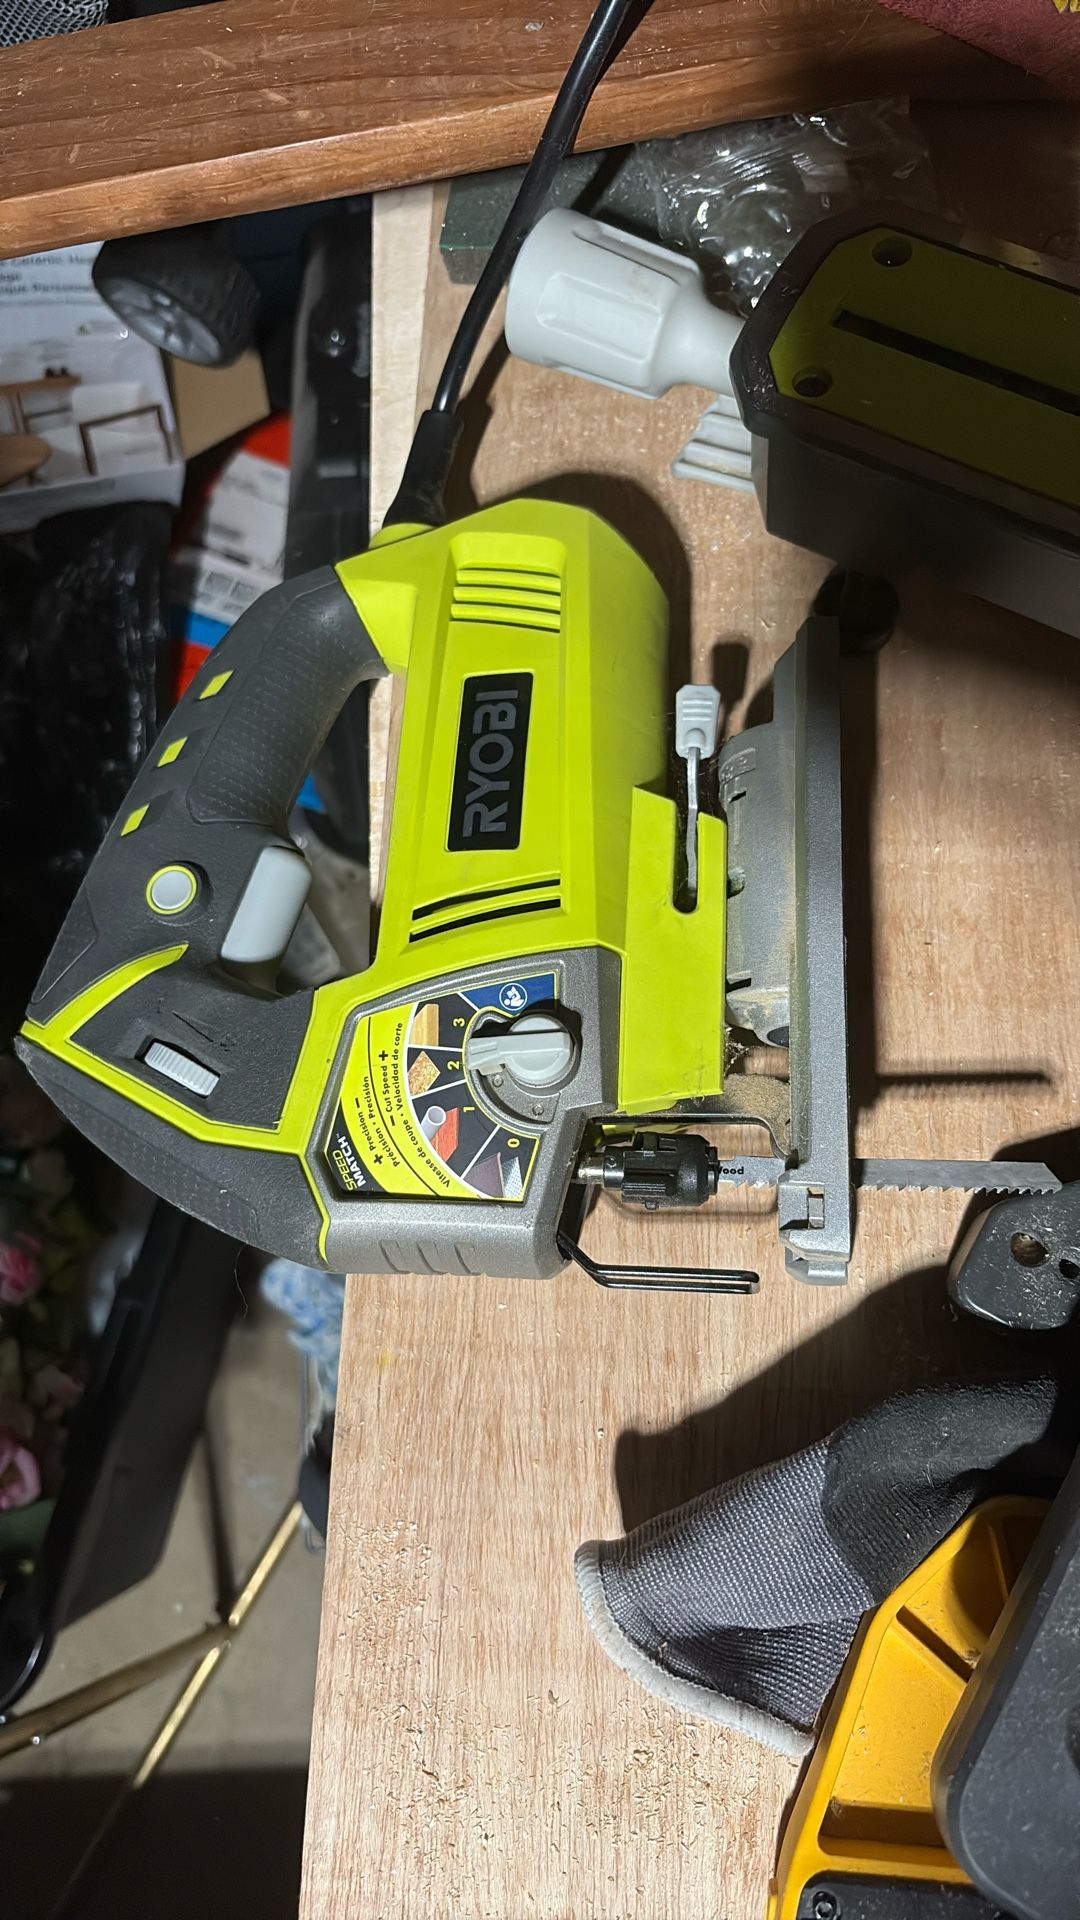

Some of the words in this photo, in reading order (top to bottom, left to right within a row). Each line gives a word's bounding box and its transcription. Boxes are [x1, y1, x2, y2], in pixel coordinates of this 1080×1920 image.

[462, 689, 519, 838] RYOBI
[394, 1022, 404, 1047] corte
[452, 1017, 466, 1028] 3
[391, 1048, 400, 1061] de
[446, 1060, 461, 1071] 2
[380, 1065, 391, 1095] Speed
[391, 1063, 404, 1111] Velocidad
[362, 1076, 376, 1119] Precisión
[384, 1096, 393, 1113] Cut
[462, 1105, 476, 1113] 1
[357, 1111, 376, 1152] Precision
[403, 1119, 419, 1146] coupe
[507, 1137, 521, 1149] 0
[374, 1127, 401, 1168] Précision
[416, 1145, 427, 1158] de
[332, 1149, 358, 1191] SPEED
[425, 1159, 452, 1188] Vitesse
[718, 1166, 745, 1175] ood
